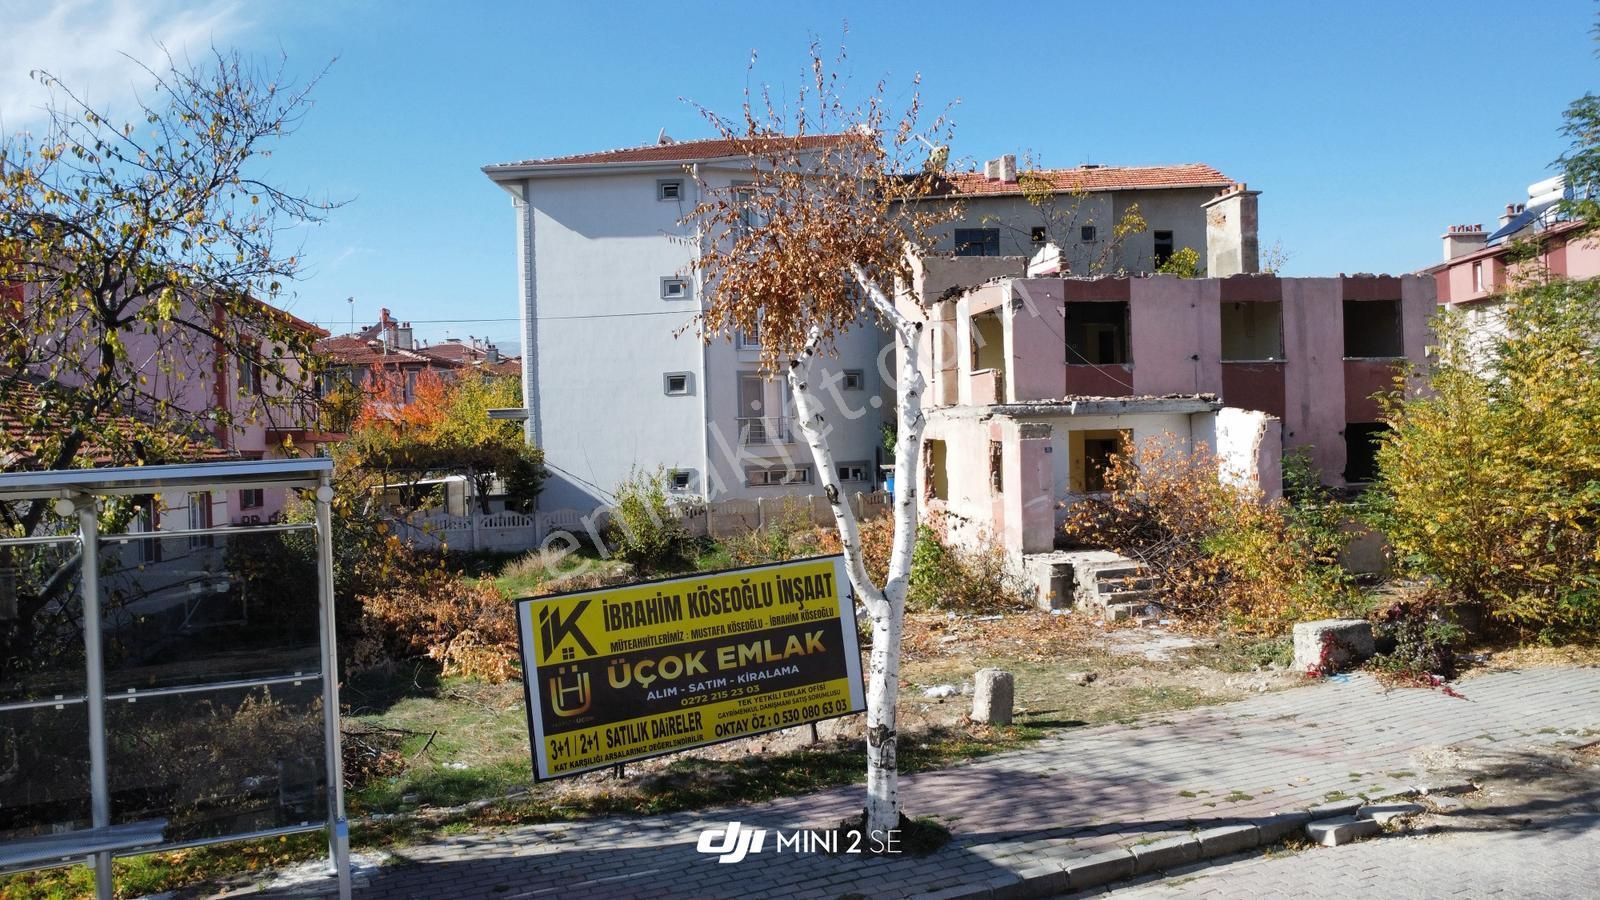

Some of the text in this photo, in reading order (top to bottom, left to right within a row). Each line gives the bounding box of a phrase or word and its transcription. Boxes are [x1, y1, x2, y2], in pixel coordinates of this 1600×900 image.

[602, 573, 832, 632] İBRAHİM KÖSEOĞLU İNŞAAT
[610, 630, 684, 653] MÜTEAHHİTLERİMİZ
[691, 624, 725, 640] MUSTAFA
[727, 618, 763, 633] KÖSEOĞLU
[770, 612, 799, 627] İBRAHİM
[801, 606, 834, 621] KÖSEOĞLU
[608, 630, 826, 688] ÜÇOK EMLAK
[647, 687, 677, 700] ALIM
[689, 678, 726, 692] SATIM
[738, 665, 799, 684] KİRALAMA
[681, 685, 760, 705] 0272 215 23 03
[738, 683, 826, 706] TEK YETKİLİ EMLAK OFİSİ
[715, 718, 749, 737] OKTAY
[752, 713, 766, 729] ÖZ
[774, 712, 779, 725] 0
[782, 708, 799, 723] 530
[802, 704, 820, 719] 080
[822, 701, 833, 714] 63
[835, 699, 847, 711] 03
[551, 736, 570, 760] 3+1
[580, 731, 599, 754] 2+1
[606, 721, 649, 748] SATILIK
[554, 762, 567, 772] KAT
[569, 754, 603, 768] KARŞILIĞI
[605, 746, 647, 760] ARSALARINIZ
